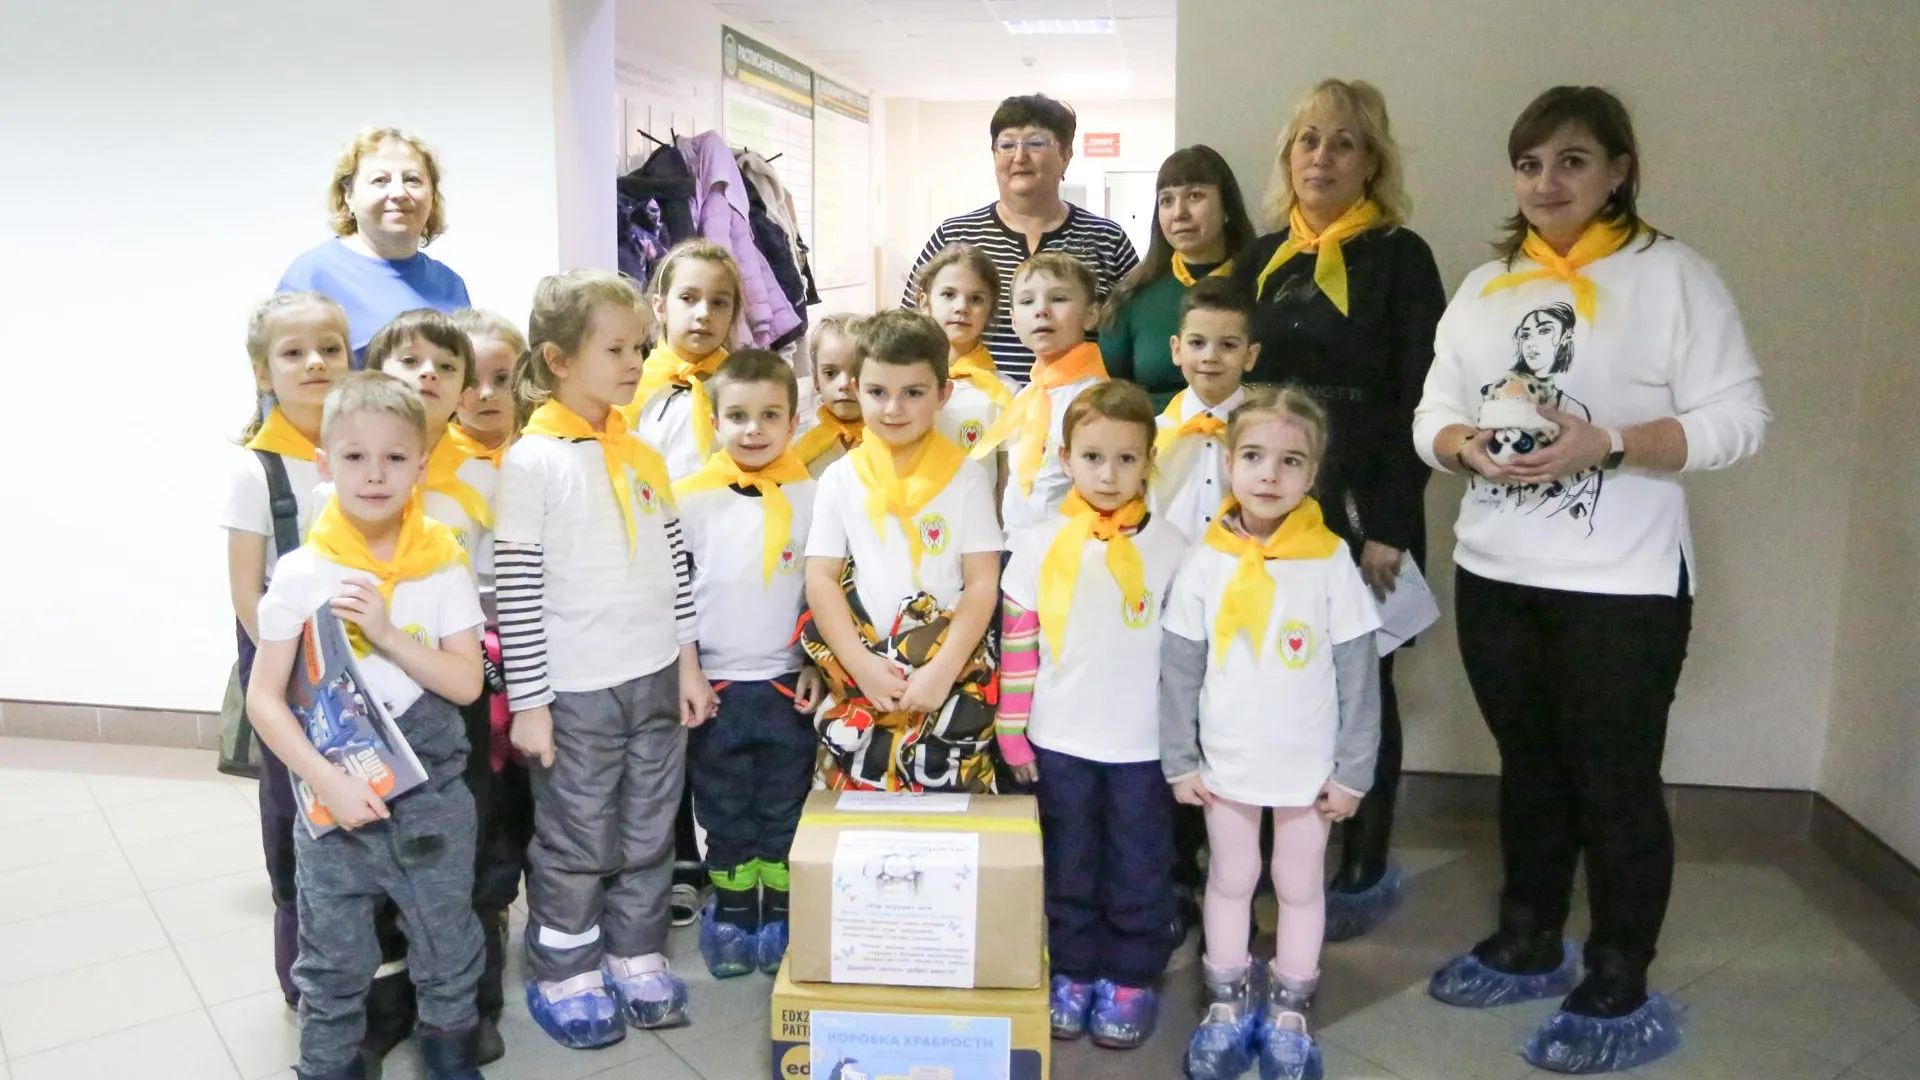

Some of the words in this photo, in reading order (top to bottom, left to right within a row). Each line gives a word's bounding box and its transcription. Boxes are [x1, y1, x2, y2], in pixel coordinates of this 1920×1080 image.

[782, 1023, 810, 1037] PATT
[827, 1032, 901, 1047] КОРОБКА
[904, 1033, 995, 1049] ХРАБРОСТИ
